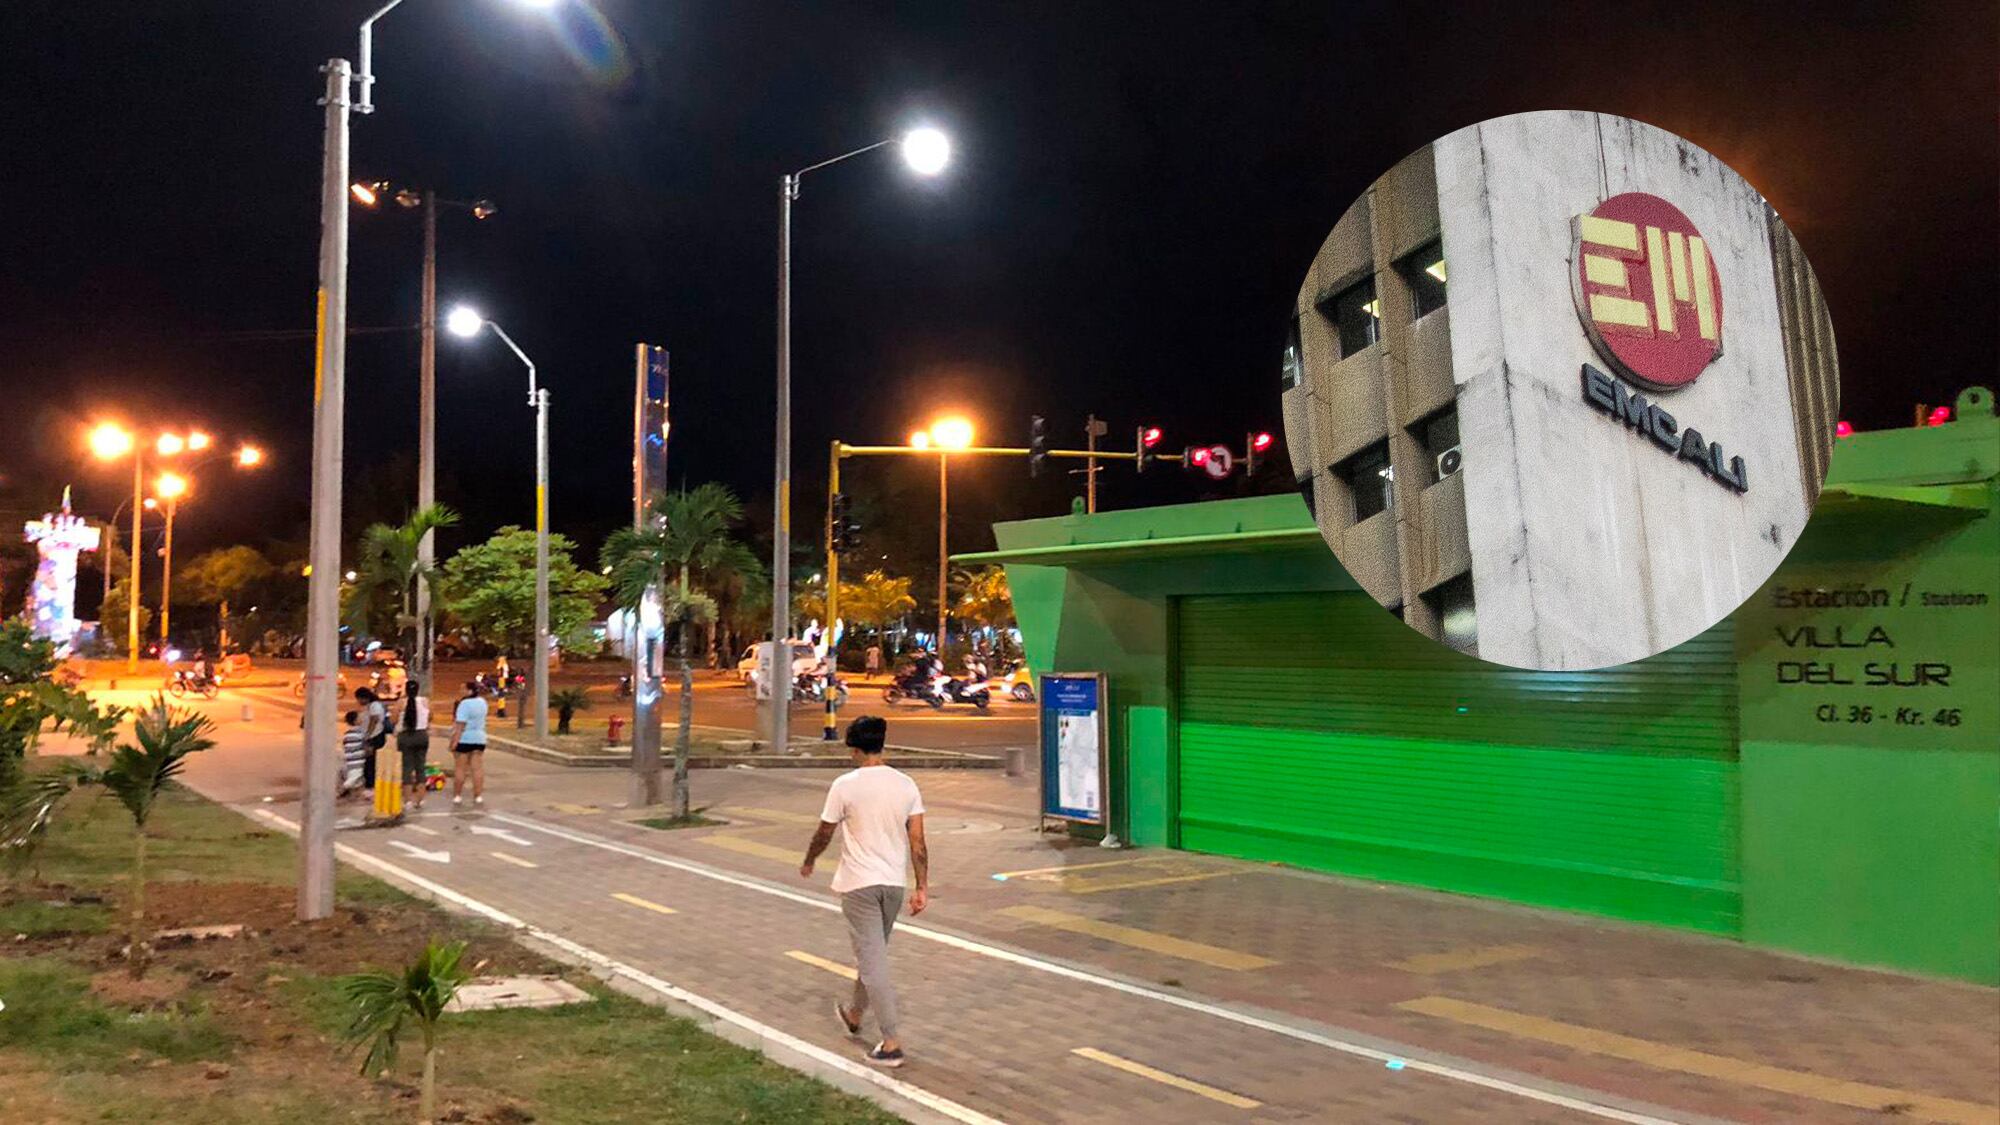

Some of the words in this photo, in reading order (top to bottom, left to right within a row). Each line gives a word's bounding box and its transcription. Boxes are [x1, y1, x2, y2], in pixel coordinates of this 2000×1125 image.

[1581, 363, 1749, 493] EMCALI
[1771, 583, 1889, 608] Estación
[1921, 590, 1988, 606] Station
[1776, 625, 1894, 648] VILLA
[1777, 661, 1854, 685] DEL
[1864, 662, 1952, 687] SUR
[1847, 705, 1873, 724] 36
[1895, 707, 1925, 726] Kr.
[1933, 708, 1962, 727] 46
